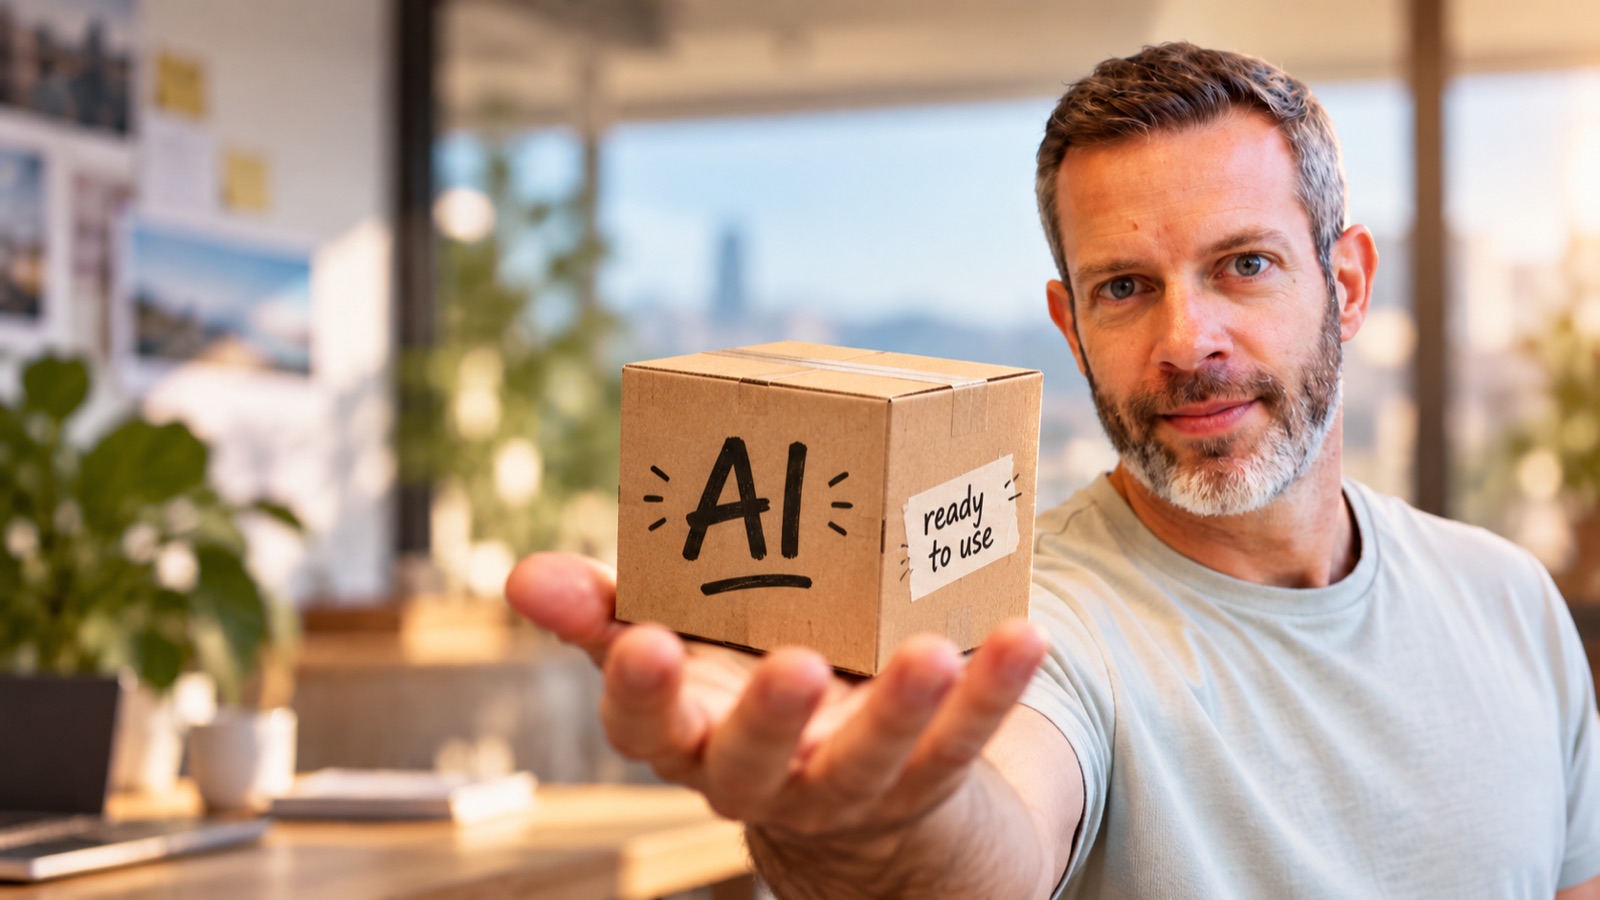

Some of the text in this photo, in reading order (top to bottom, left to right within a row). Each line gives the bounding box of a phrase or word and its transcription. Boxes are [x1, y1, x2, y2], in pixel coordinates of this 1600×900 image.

[682, 436, 808, 561] AI
[924, 483, 984, 536] ready
[928, 526, 994, 573] to use
